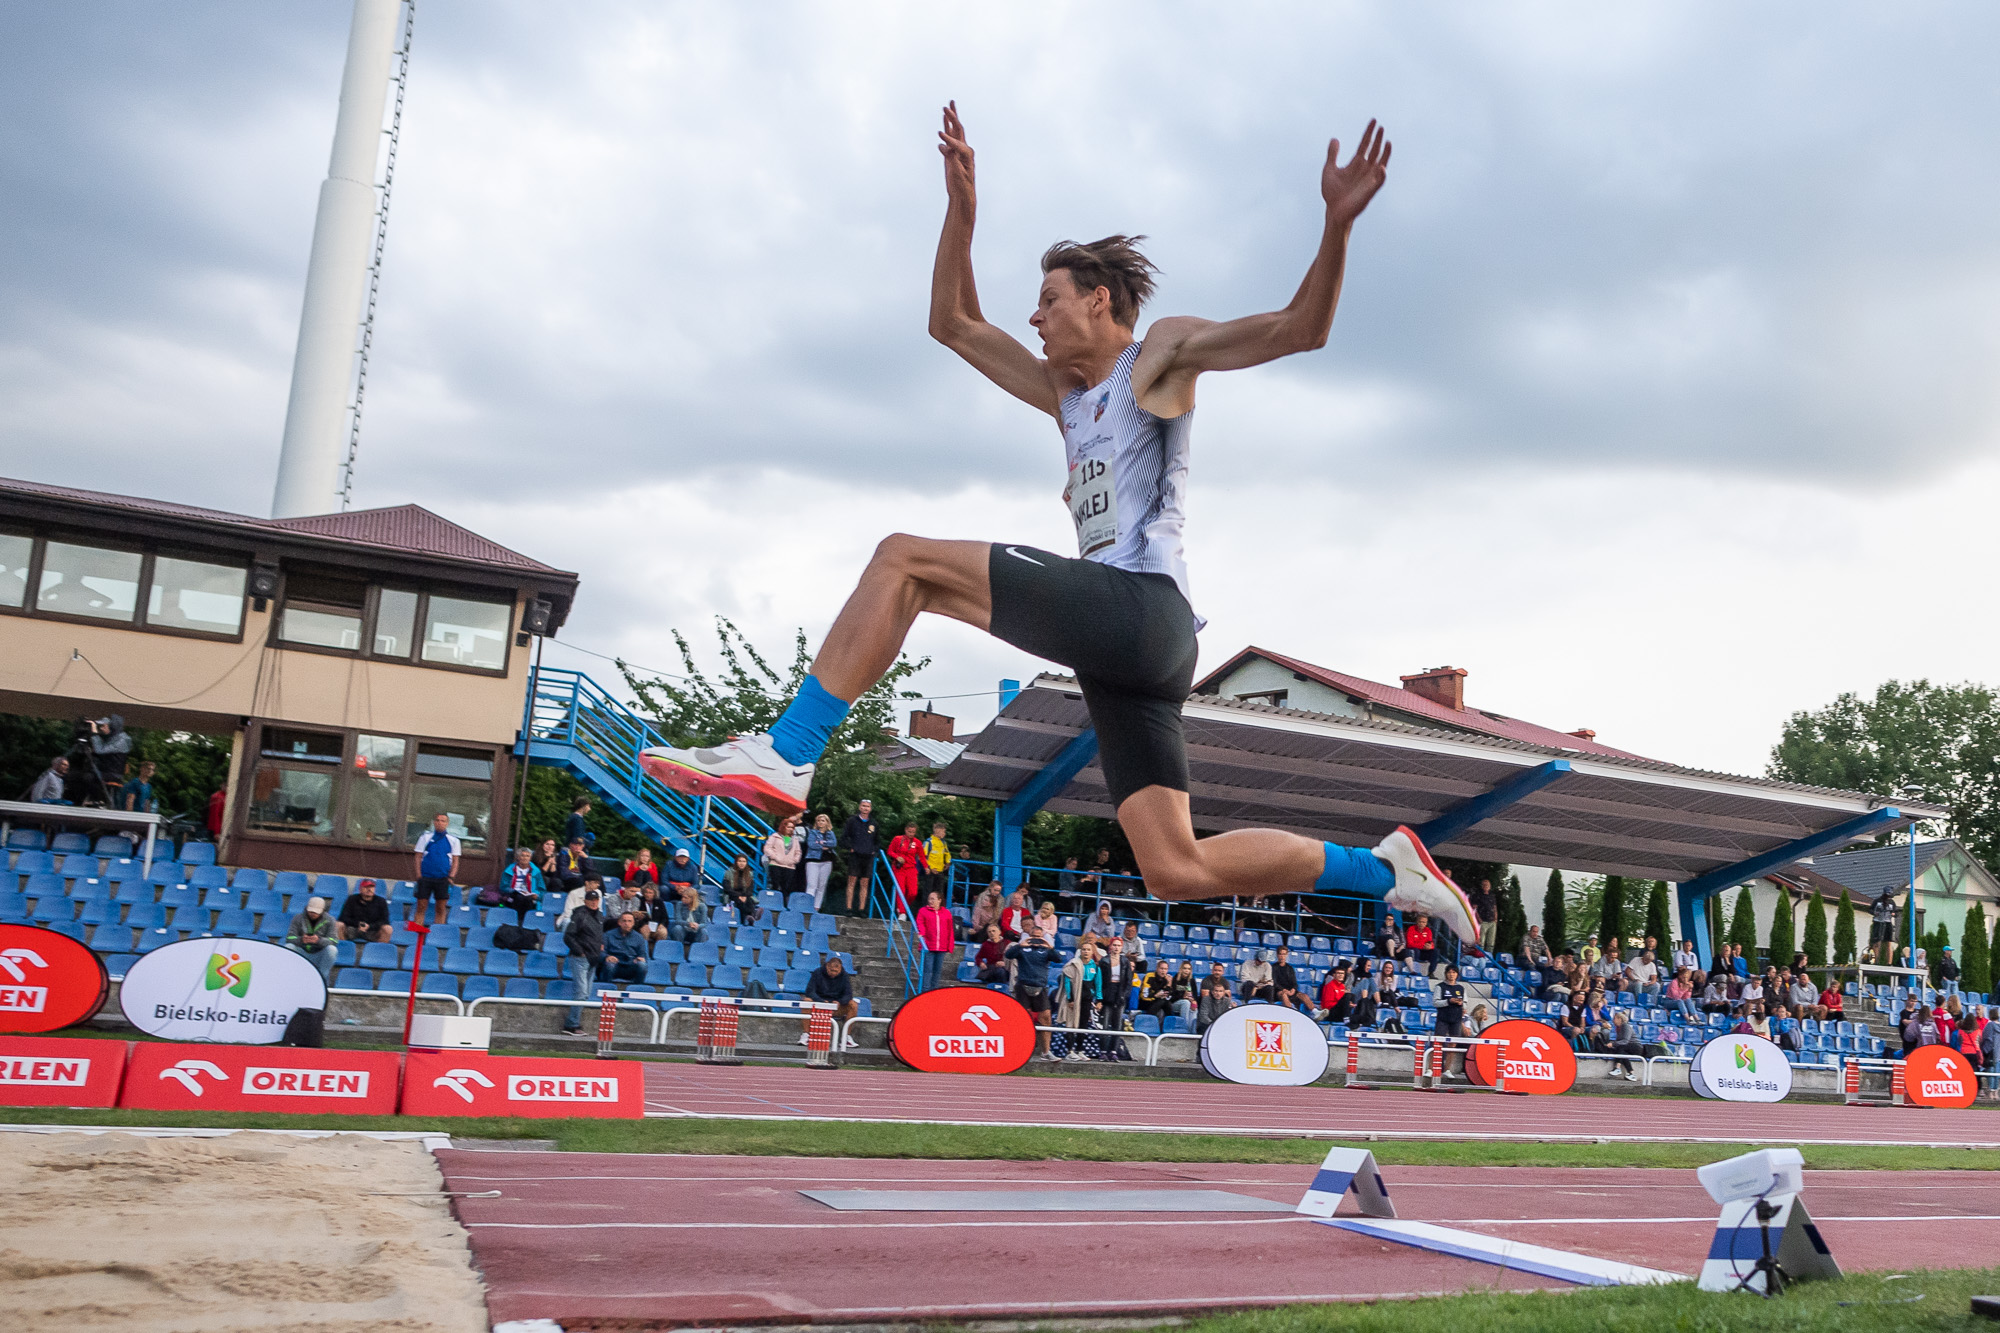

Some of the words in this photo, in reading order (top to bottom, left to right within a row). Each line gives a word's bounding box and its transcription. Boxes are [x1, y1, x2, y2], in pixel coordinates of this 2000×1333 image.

[1081, 459, 1106, 486] 115
[154, 1003, 288, 1025] Bielsko-Biała
[933, 1038, 999, 1054] ORLEN
[1248, 1053, 1289, 1069] PZLA
[1505, 1062, 1551, 1078] ORLEN
[251, 1072, 360, 1093] ORLEN
[515, 1079, 610, 1098] ORLEN
[1718, 1078, 1778, 1091] Bielsko-Biała
[1925, 1083, 1960, 1095] ORLEN
